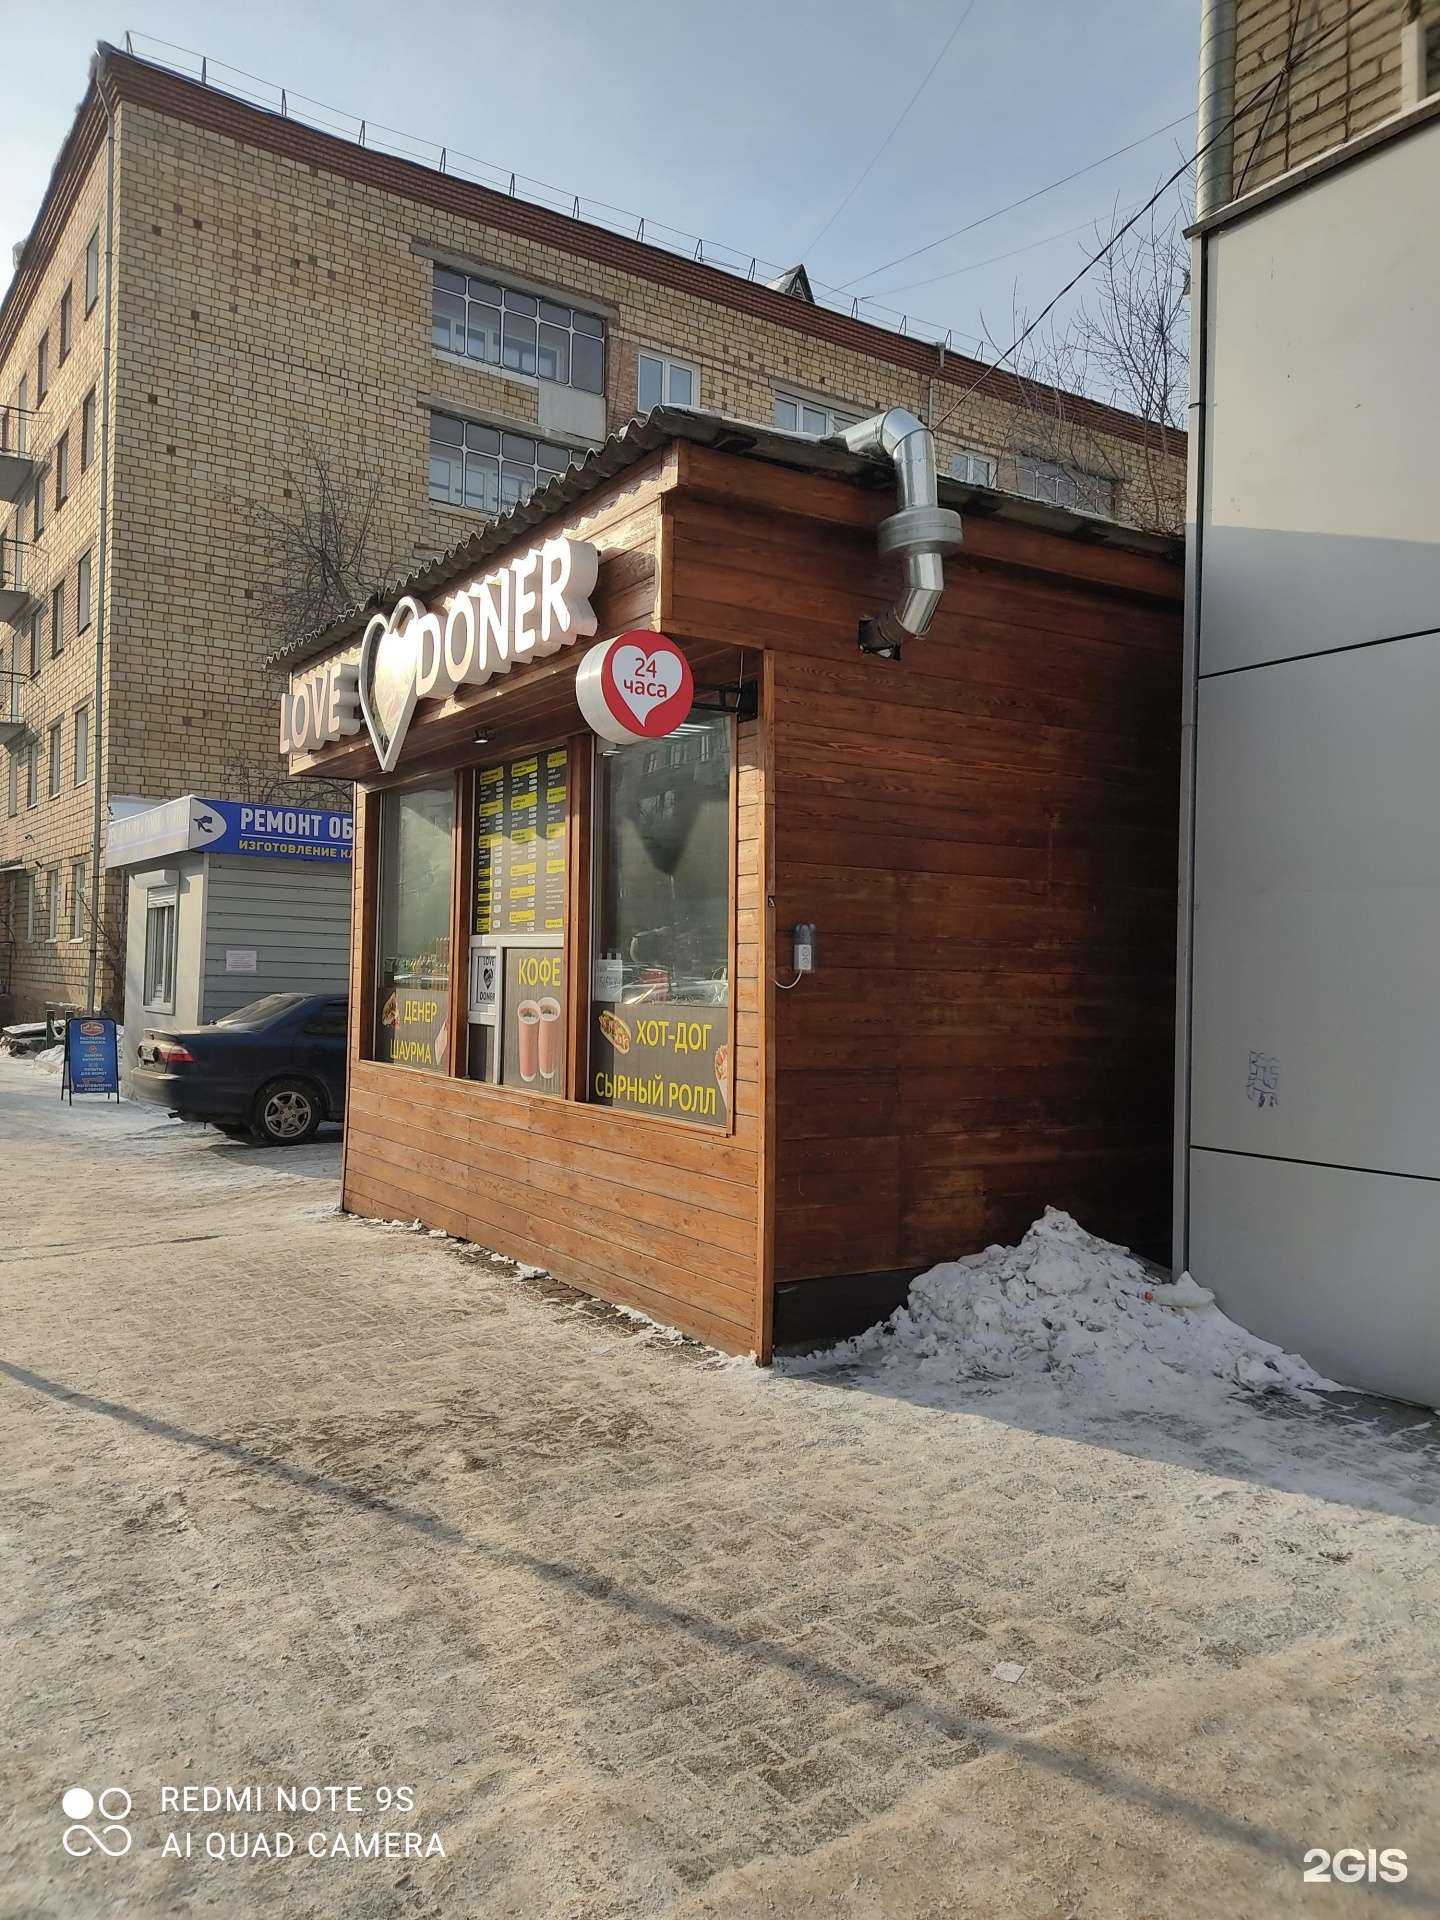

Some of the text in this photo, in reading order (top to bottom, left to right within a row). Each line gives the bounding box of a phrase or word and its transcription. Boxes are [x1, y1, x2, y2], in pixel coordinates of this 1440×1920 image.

[279, 537, 577, 754] LOVE DONER
[633, 657, 658, 678] 24
[623, 679, 668, 699] часа
[240, 807, 323, 838] РЕМОНТ
[238, 840, 337, 857] ИЗГОТОВЛЕНИЕ
[518, 957, 562, 988] КОФЕ
[403, 999, 438, 1024] ДЕНЕР
[635, 1019, 713, 1054] ХОТ-ДОГ
[389, 1039, 432, 1065] ШАУРМА
[595, 1071, 717, 1115] СЫРНЫЙ РОЛЛ
